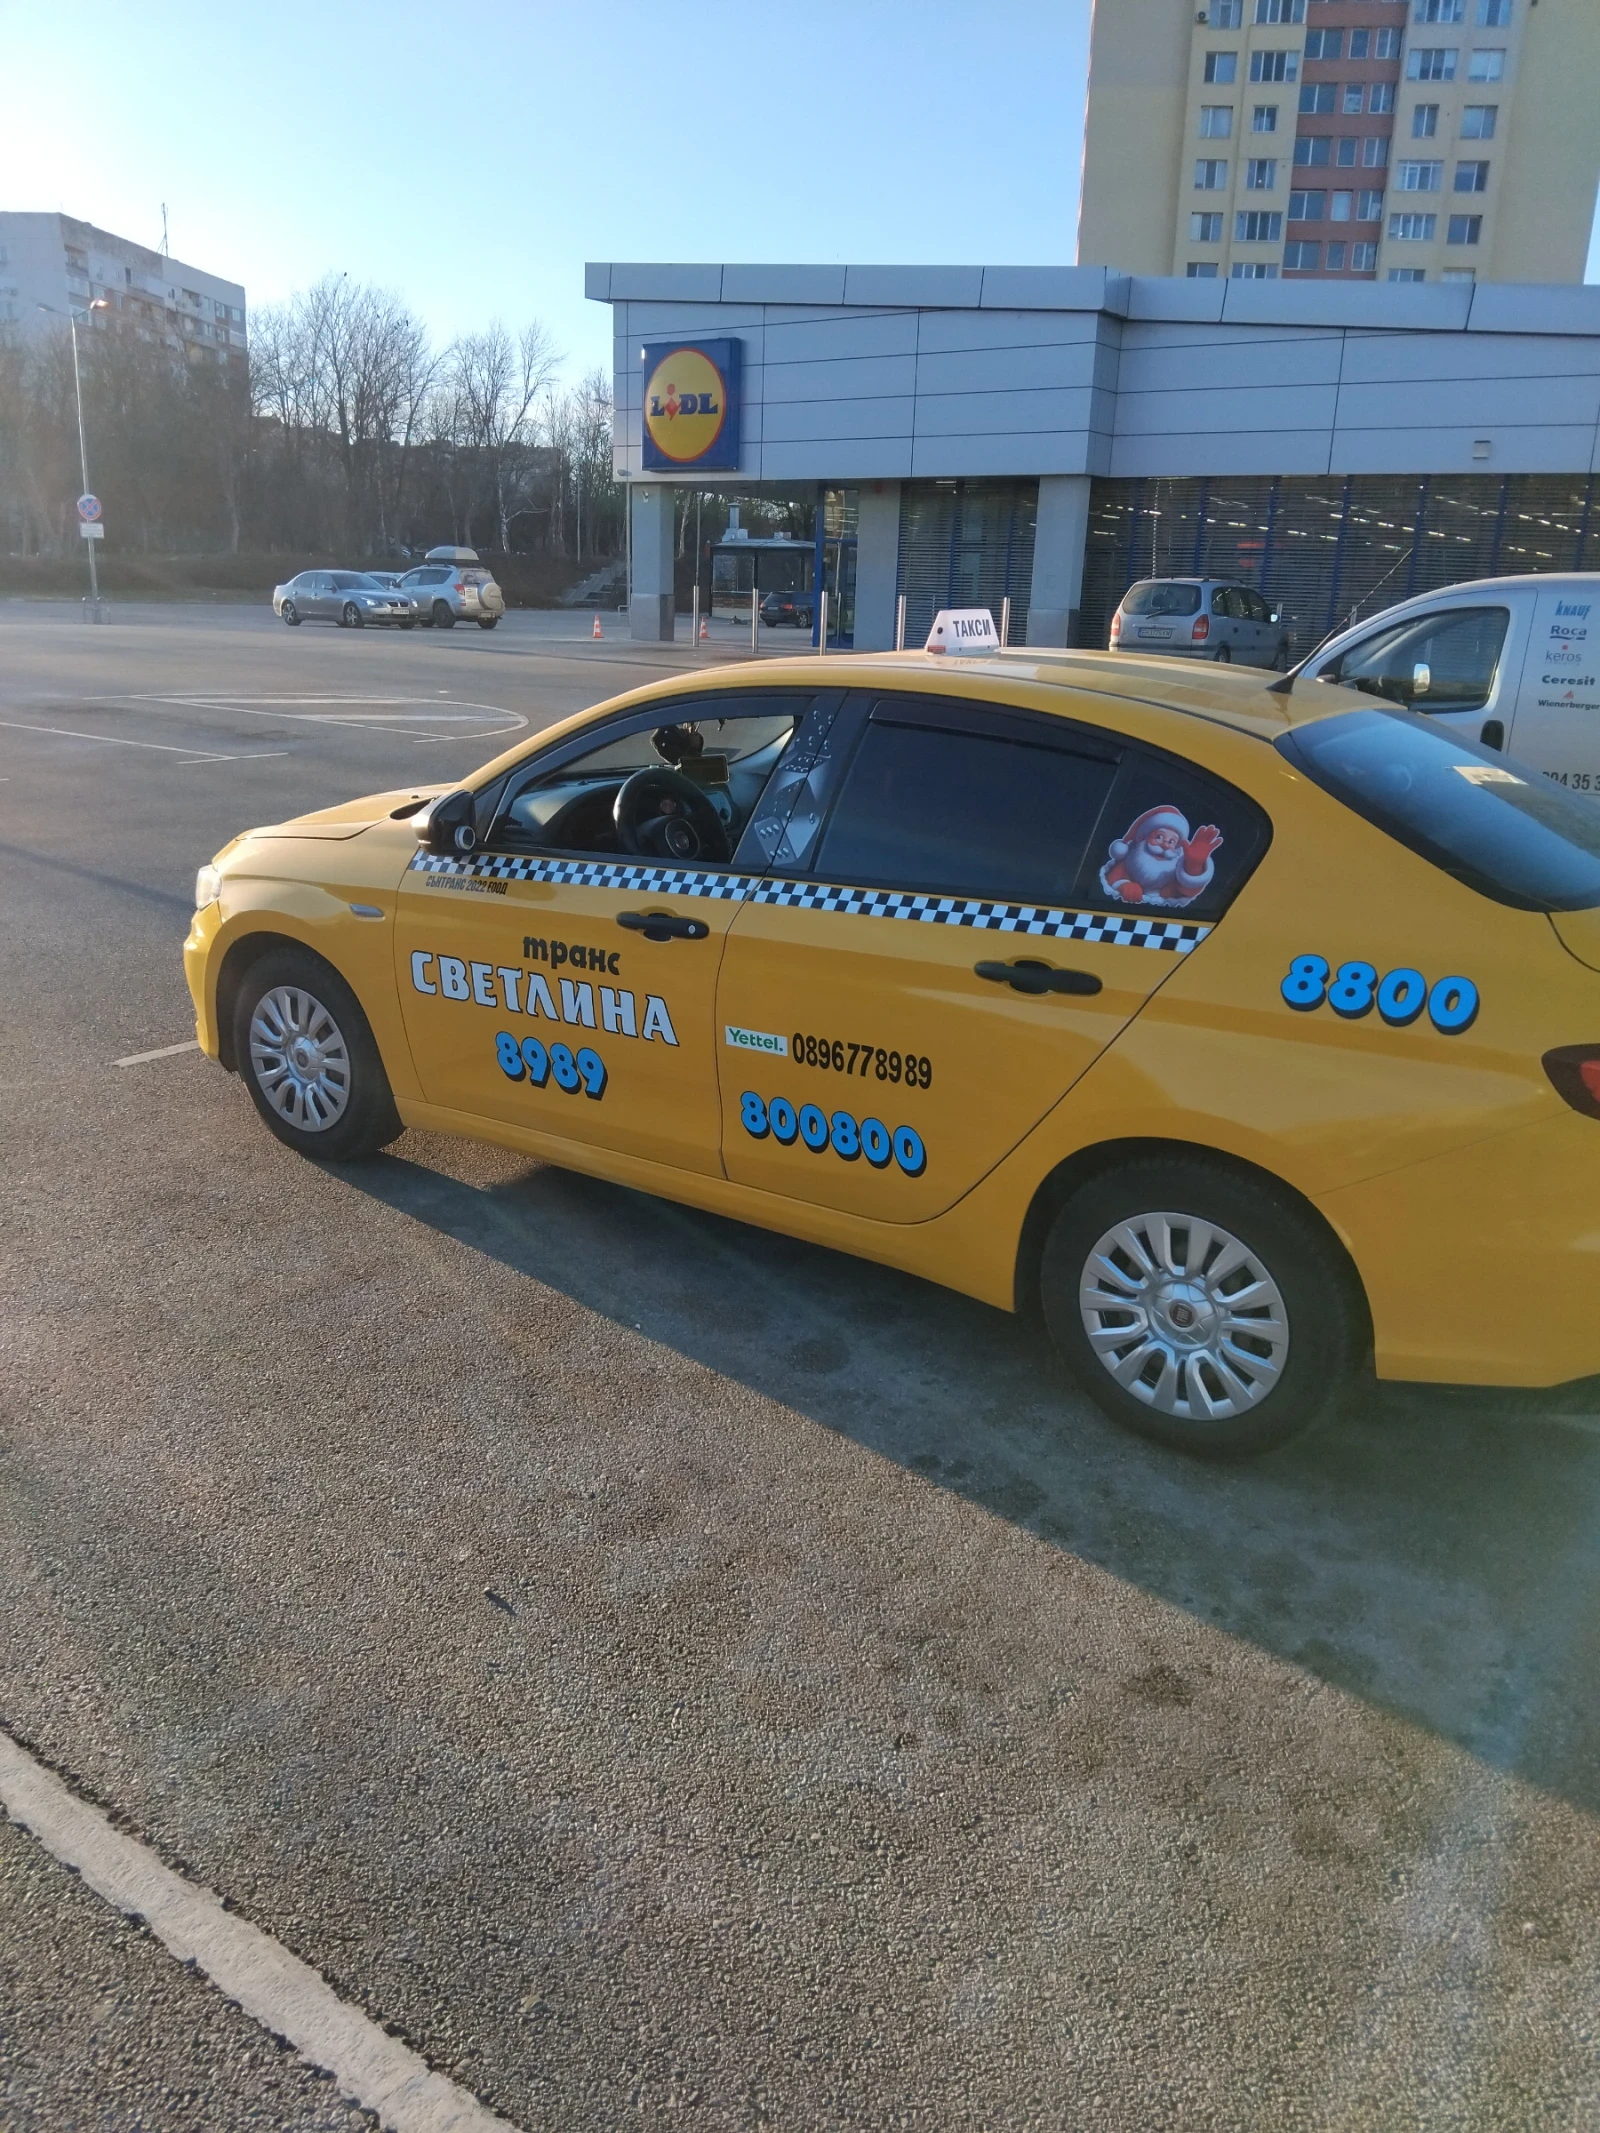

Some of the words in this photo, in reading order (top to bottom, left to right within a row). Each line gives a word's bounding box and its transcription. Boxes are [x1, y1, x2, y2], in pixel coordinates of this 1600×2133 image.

[952, 619, 991, 637] ТАКСИ
[1550, 625, 1588, 636] Roca
[1545, 649, 1582, 662] keros
[1542, 674, 1596, 686] Ceresit
[1538, 699, 1600, 711] Wienerberger
[1572, 773, 1590, 790] 35
[466, 879, 487, 893] 2022
[486, 881, 509, 895] ЕООД
[522, 936, 621, 976] транс
[410, 950, 680, 1047] СВЕТЛИНА
[1280, 954, 1480, 1036] 8800
[495, 1031, 608, 1101] 8989
[792, 1032, 932, 1090] 0896778989
[740, 1090, 927, 1178] 800800
